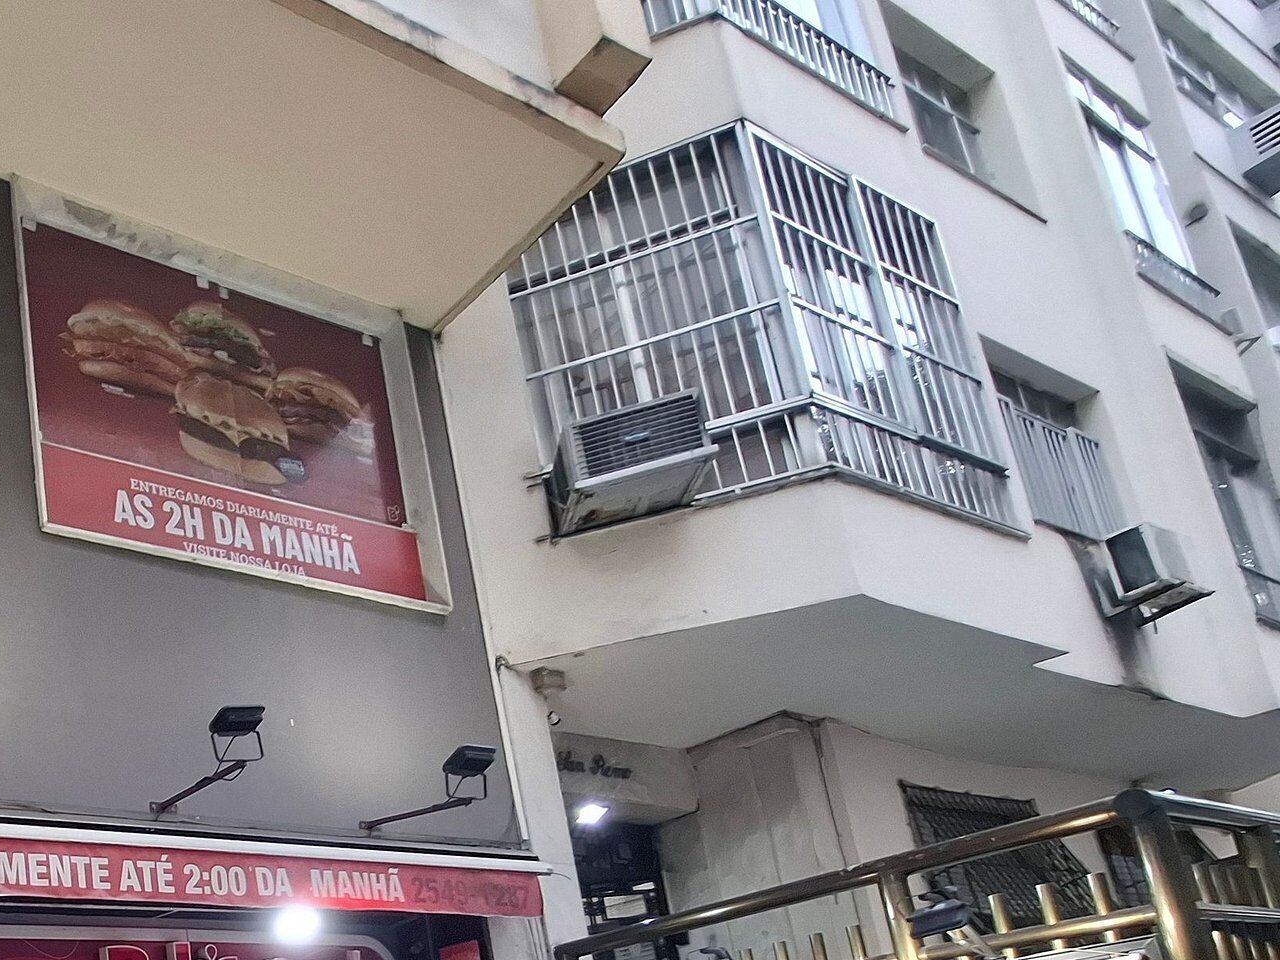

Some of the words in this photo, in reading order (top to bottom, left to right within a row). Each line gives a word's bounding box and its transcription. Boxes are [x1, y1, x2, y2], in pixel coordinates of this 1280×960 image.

[114, 490, 155, 530] AS
[163, 501, 205, 540] 2H
[212, 511, 255, 551] DA
[260, 522, 361, 575] MANHÃ
[130, 478, 224, 510] ENTREGAMOS
[227, 501, 313, 530] DIARIAMENTE
[316, 522, 339, 537] ATÉ
[183, 541, 227, 559] VISITE
[230, 551, 271, 569] NOSSA
[119, 852, 175, 894] ATÉ
[183, 863, 246, 897] 2:00
[256, 866, 292, 897] DA
[311, 867, 405, 903] MANHÃ
